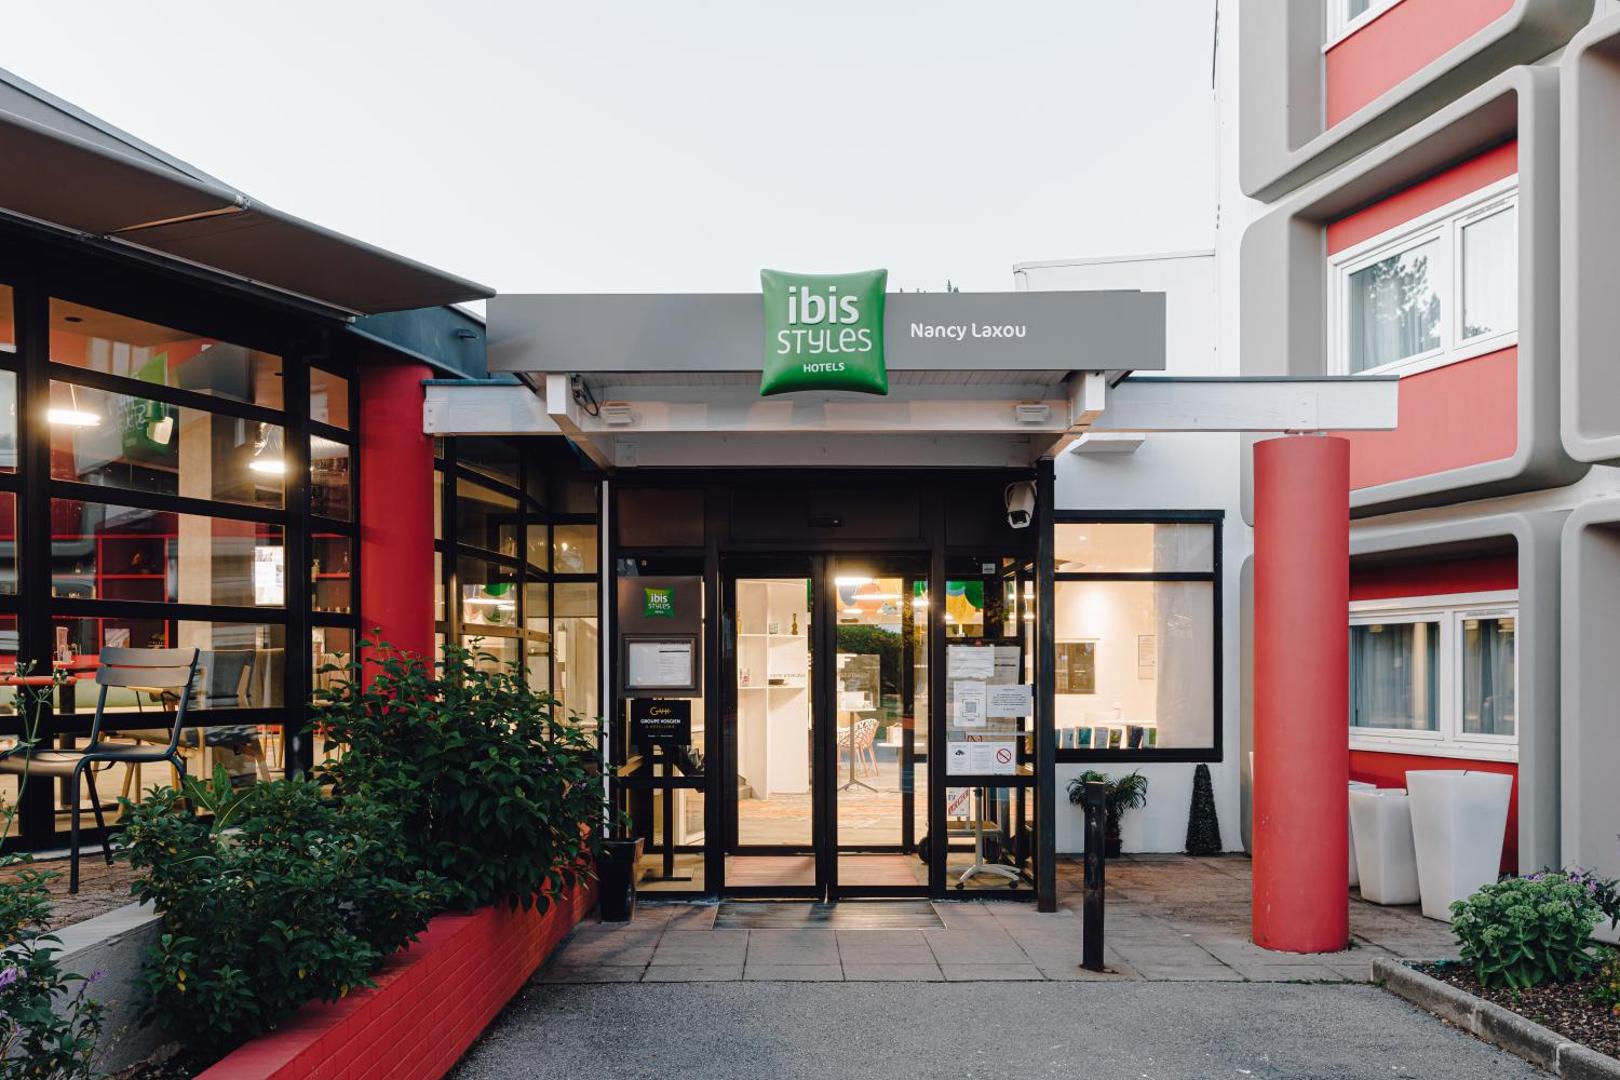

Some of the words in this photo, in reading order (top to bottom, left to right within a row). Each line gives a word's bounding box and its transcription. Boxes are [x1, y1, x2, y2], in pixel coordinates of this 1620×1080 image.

[788, 286, 859, 325] ibis
[910, 322, 967, 340] Nancy
[972, 322, 1026, 338] Laxou
[803, 362, 845, 372] HOTELS
[651, 593, 668, 603] ibis
